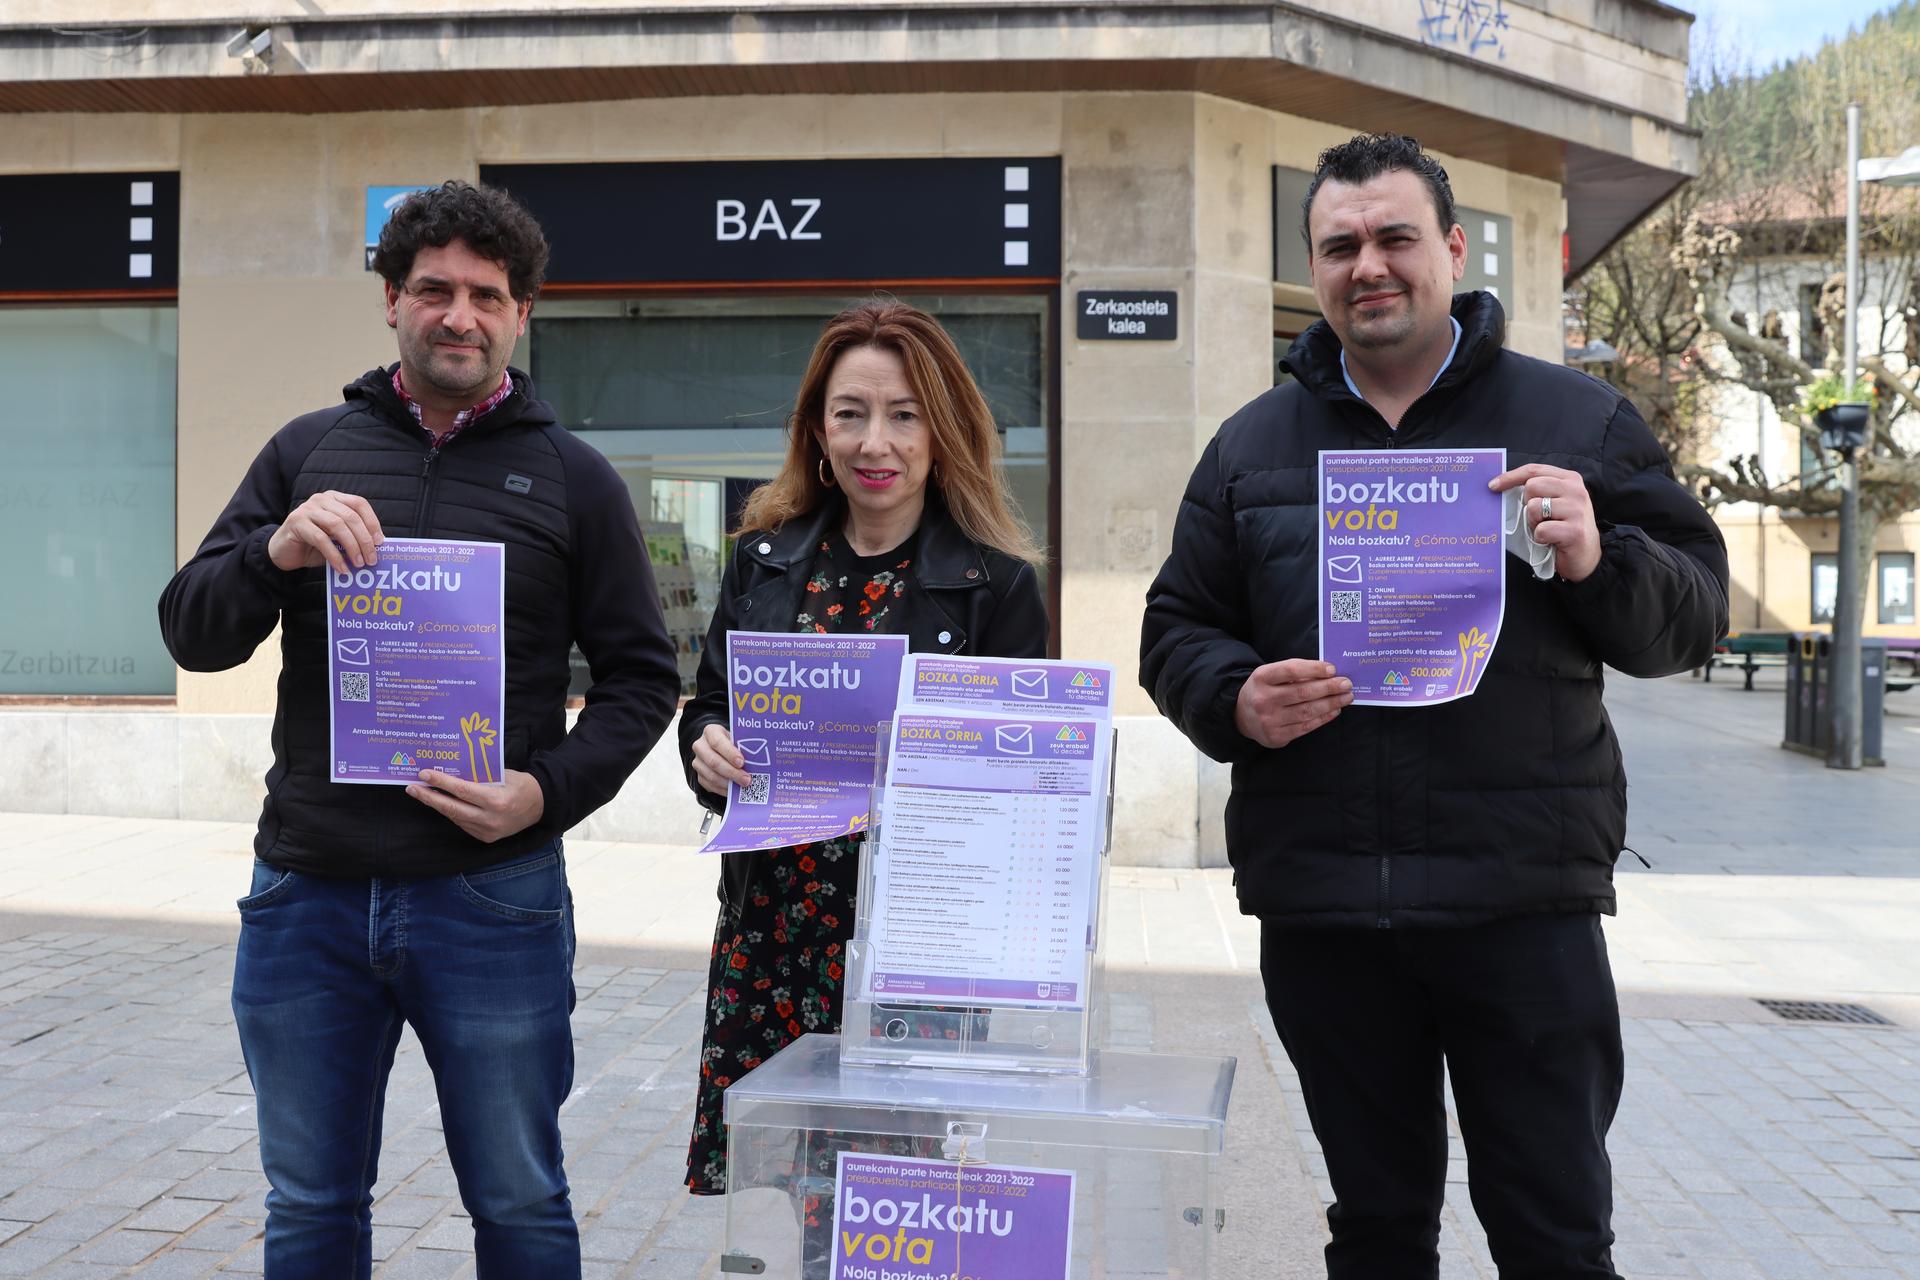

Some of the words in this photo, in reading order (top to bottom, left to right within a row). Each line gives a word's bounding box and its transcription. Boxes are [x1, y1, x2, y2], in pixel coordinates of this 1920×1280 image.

[717, 199, 822, 240] BAZ
[1086, 298, 1168, 315] Zerkaosteta
[1108, 318, 1146, 334] kalea
[1326, 457, 1367, 465] aurrekontu
[1368, 457, 1389, 466] parte
[1391, 456, 1434, 464] hartzaileak
[1326, 466, 1376, 474] presupuestos
[1378, 465, 1428, 473] participativos
[1326, 476, 1459, 504] bozkatu
[1326, 504, 1398, 531] vota
[1329, 536, 1356, 546] Nola
[1358, 535, 1410, 546] bozkatu?
[1414, 534, 1457, 548] ¿Cómo
[1460, 534, 1498, 544] votar?
[397, 545, 437, 554] hartzaileak
[438, 546, 475, 556] 2021-2022
[334, 564, 461, 592] bozkatu
[333, 588, 402, 616] vota
[338, 618, 362, 629] Nola
[365, 620, 415, 631] bozkatu?
[418, 622, 460, 634] ¿Cómo
[463, 623, 497, 634] votar?
[733, 639, 770, 648] aurrekontu
[772, 640, 791, 649] parte
[793, 640, 835, 649] hartzaileak
[837, 642, 876, 650] 2021-2022
[1378, 648, 1414, 656] proposatu
[733, 648, 778, 657] presupuestos
[780, 650, 830, 658] participativos
[1, 650, 136, 674] Zerbitzua
[734, 658, 860, 690] bozkatu
[919, 672, 958, 683] BOZKA
[962, 674, 998, 686] ORRIA
[1411, 667, 1454, 677] 500.000€
[734, 688, 801, 714] vota
[352, 728, 384, 736] Arrasatek
[386, 729, 418, 738] proposatu
[738, 717, 762, 728] Nola
[764, 718, 814, 730] bozkatu?
[818, 721, 860, 734] ¿Cómo
[901, 728, 941, 739] BOZKA
[946, 730, 982, 742] ORRIA
[416, 750, 460, 760] 500.000€
[847, 1162, 898, 1174] aurrekontu
[901, 1168, 927, 1178] parte
[929, 1168, 982, 1182] hartzaleak
[985, 1174, 1034, 1186] 2021-2022
[846, 1174, 909, 1188] presupuestos
[911, 1180, 976, 1193] participatvos
[978, 1184, 1026, 1197] 2021-2022
[844, 1187, 1014, 1236] bozkatu
[842, 1228, 934, 1265] vota
[844, 1264, 876, 1280] Nola
